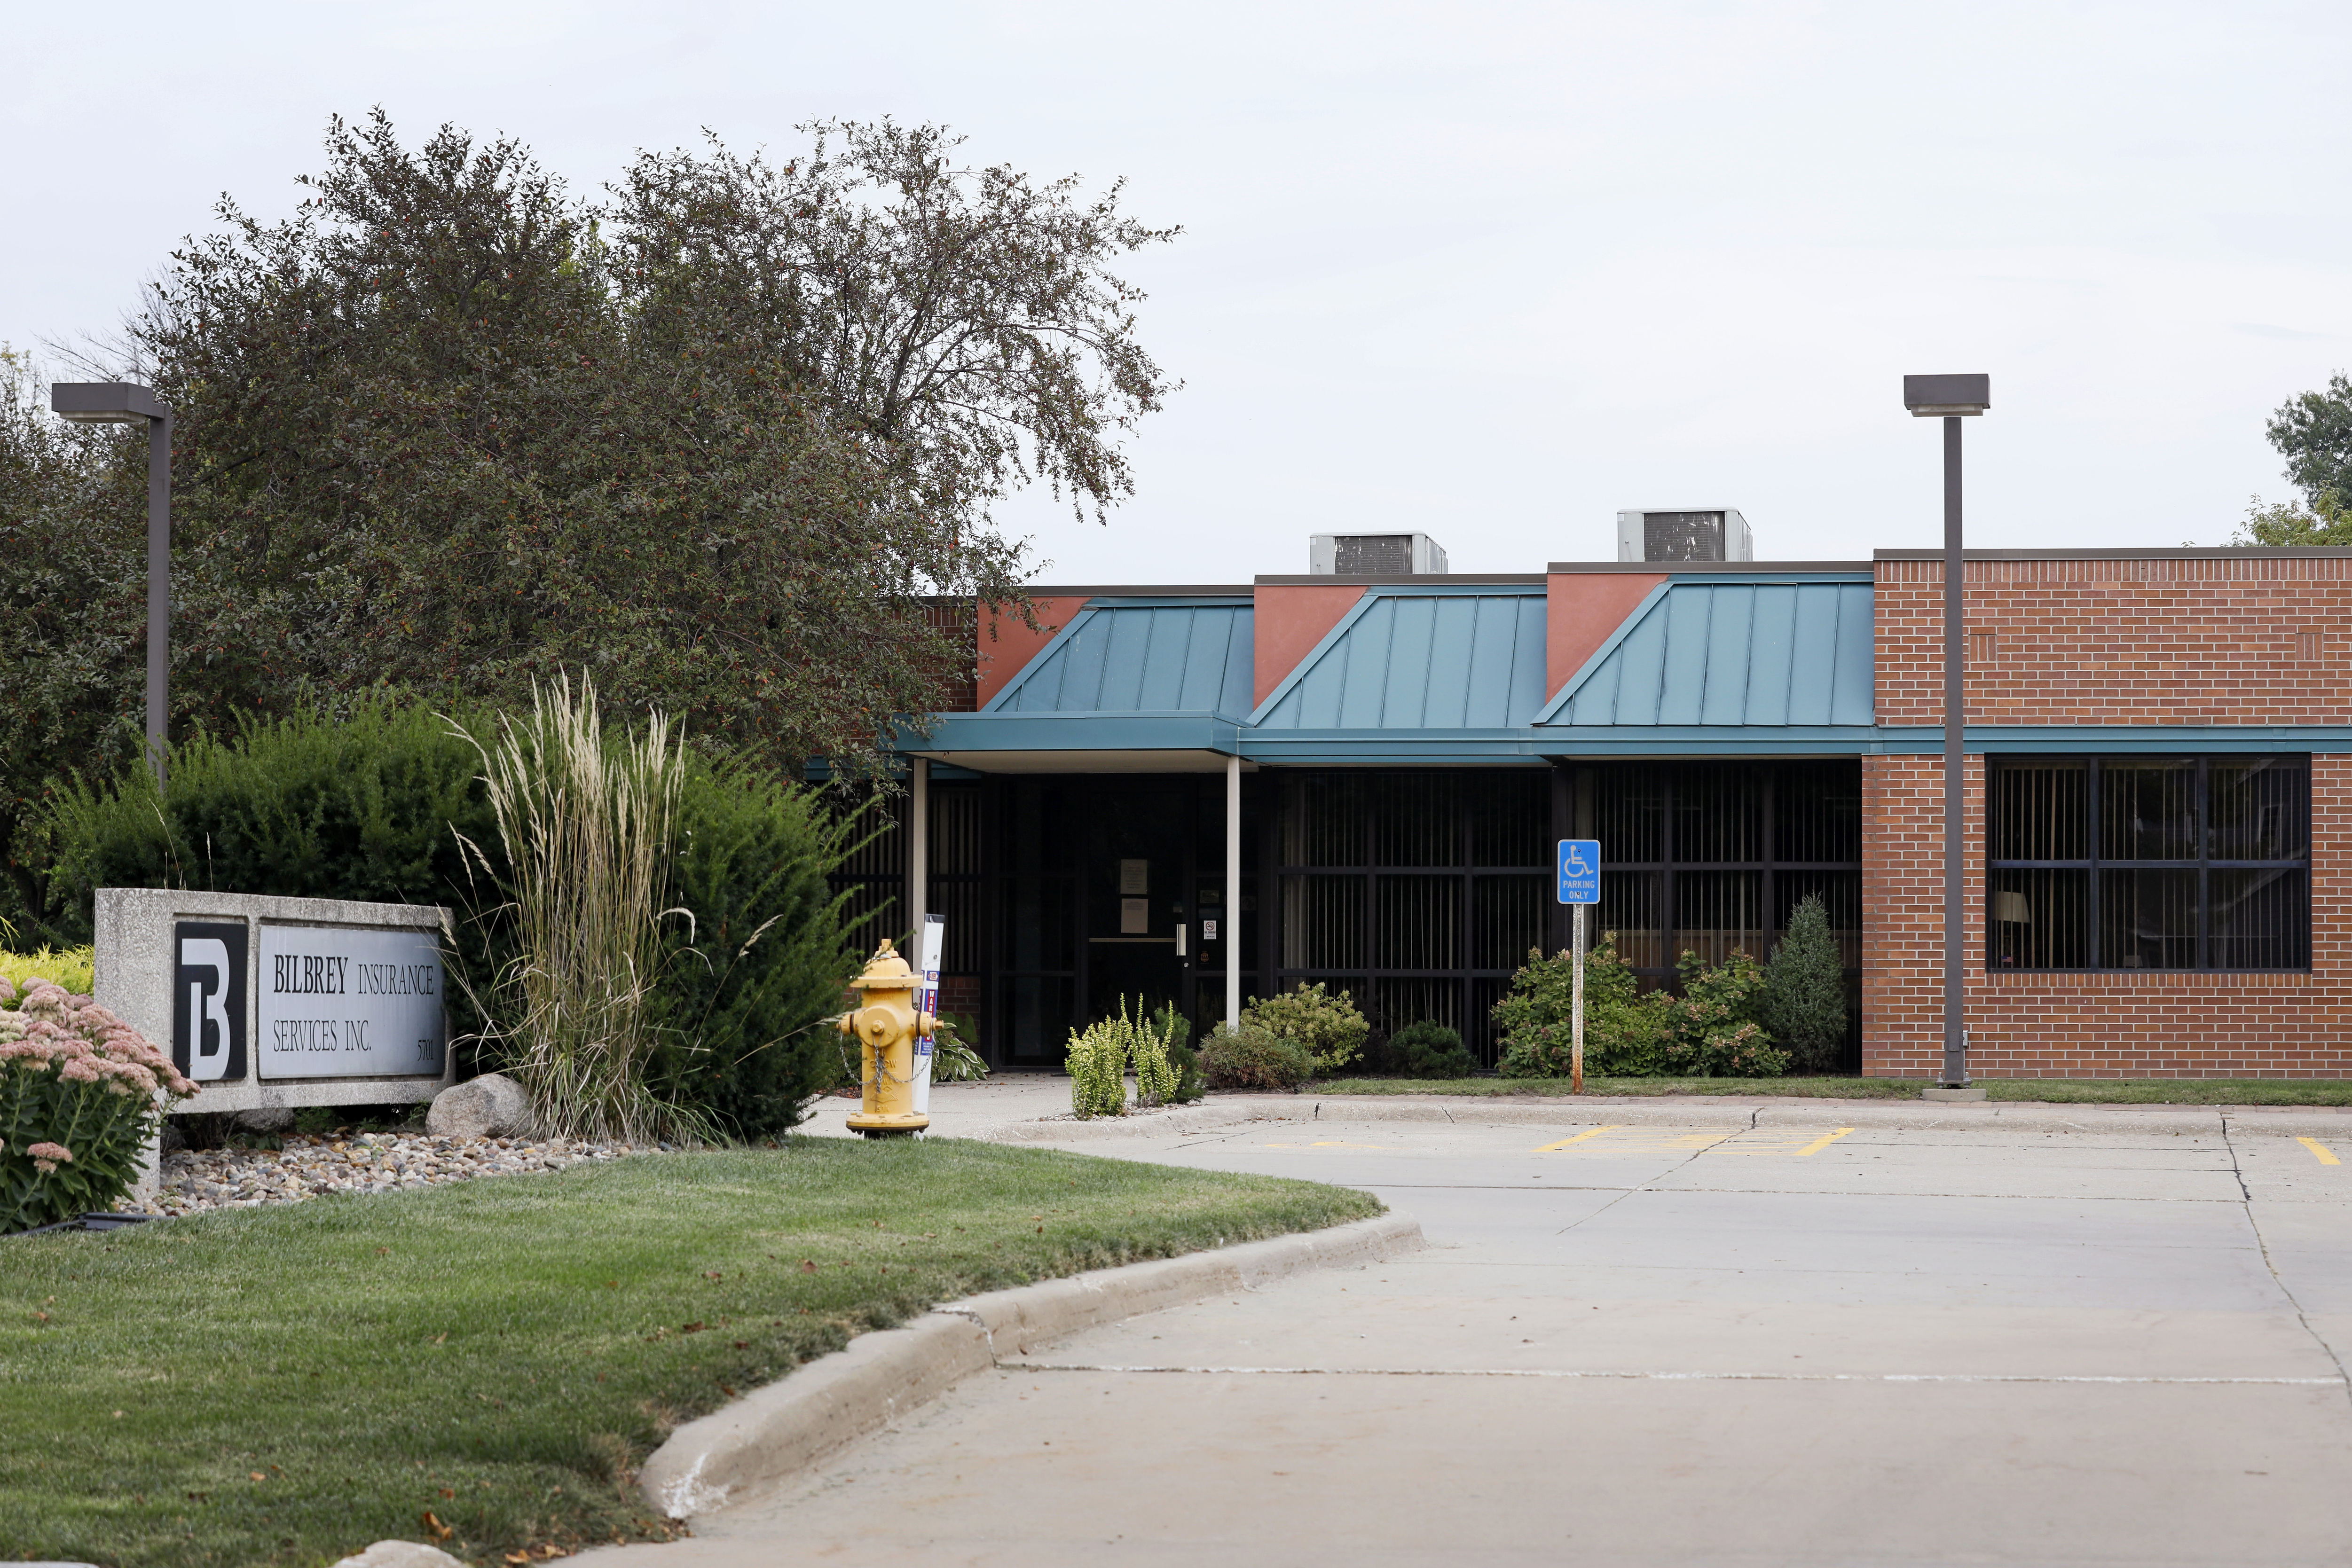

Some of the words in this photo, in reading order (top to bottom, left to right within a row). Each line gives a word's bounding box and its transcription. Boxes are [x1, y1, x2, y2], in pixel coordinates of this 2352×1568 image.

[1569, 891, 1589, 899] ONLY
[274, 955, 348, 994] BILBREY
[358, 964, 434, 995] INSURANCE
[274, 1019, 337, 1051] SERVICES
[345, 1020, 371, 1051] INC.
[417, 1039, 434, 1061] 5701
